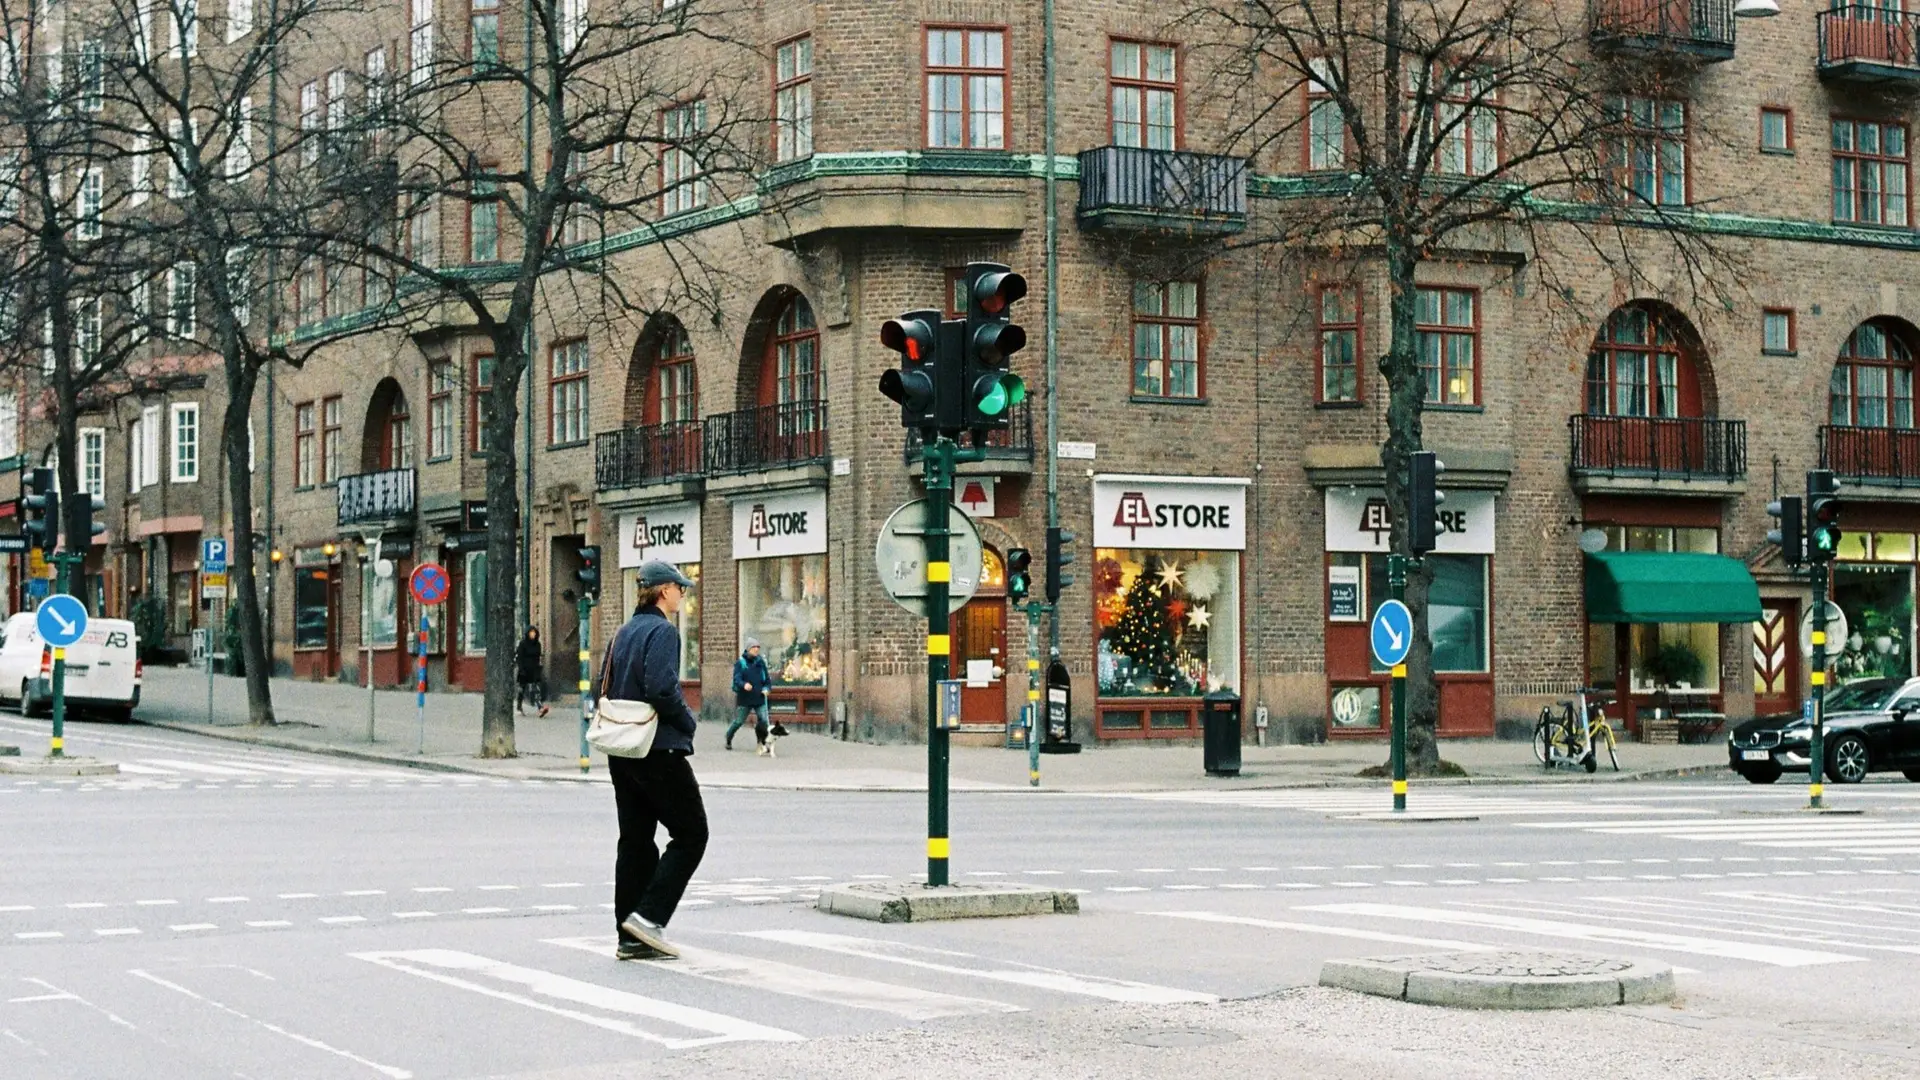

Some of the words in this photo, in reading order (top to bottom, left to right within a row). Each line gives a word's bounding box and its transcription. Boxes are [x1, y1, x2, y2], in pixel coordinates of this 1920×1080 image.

[768, 511, 807, 536] STORE
[1155, 504, 1230, 528] STORE
[650, 523, 684, 546] STORE
[209, 541, 223, 560] P
